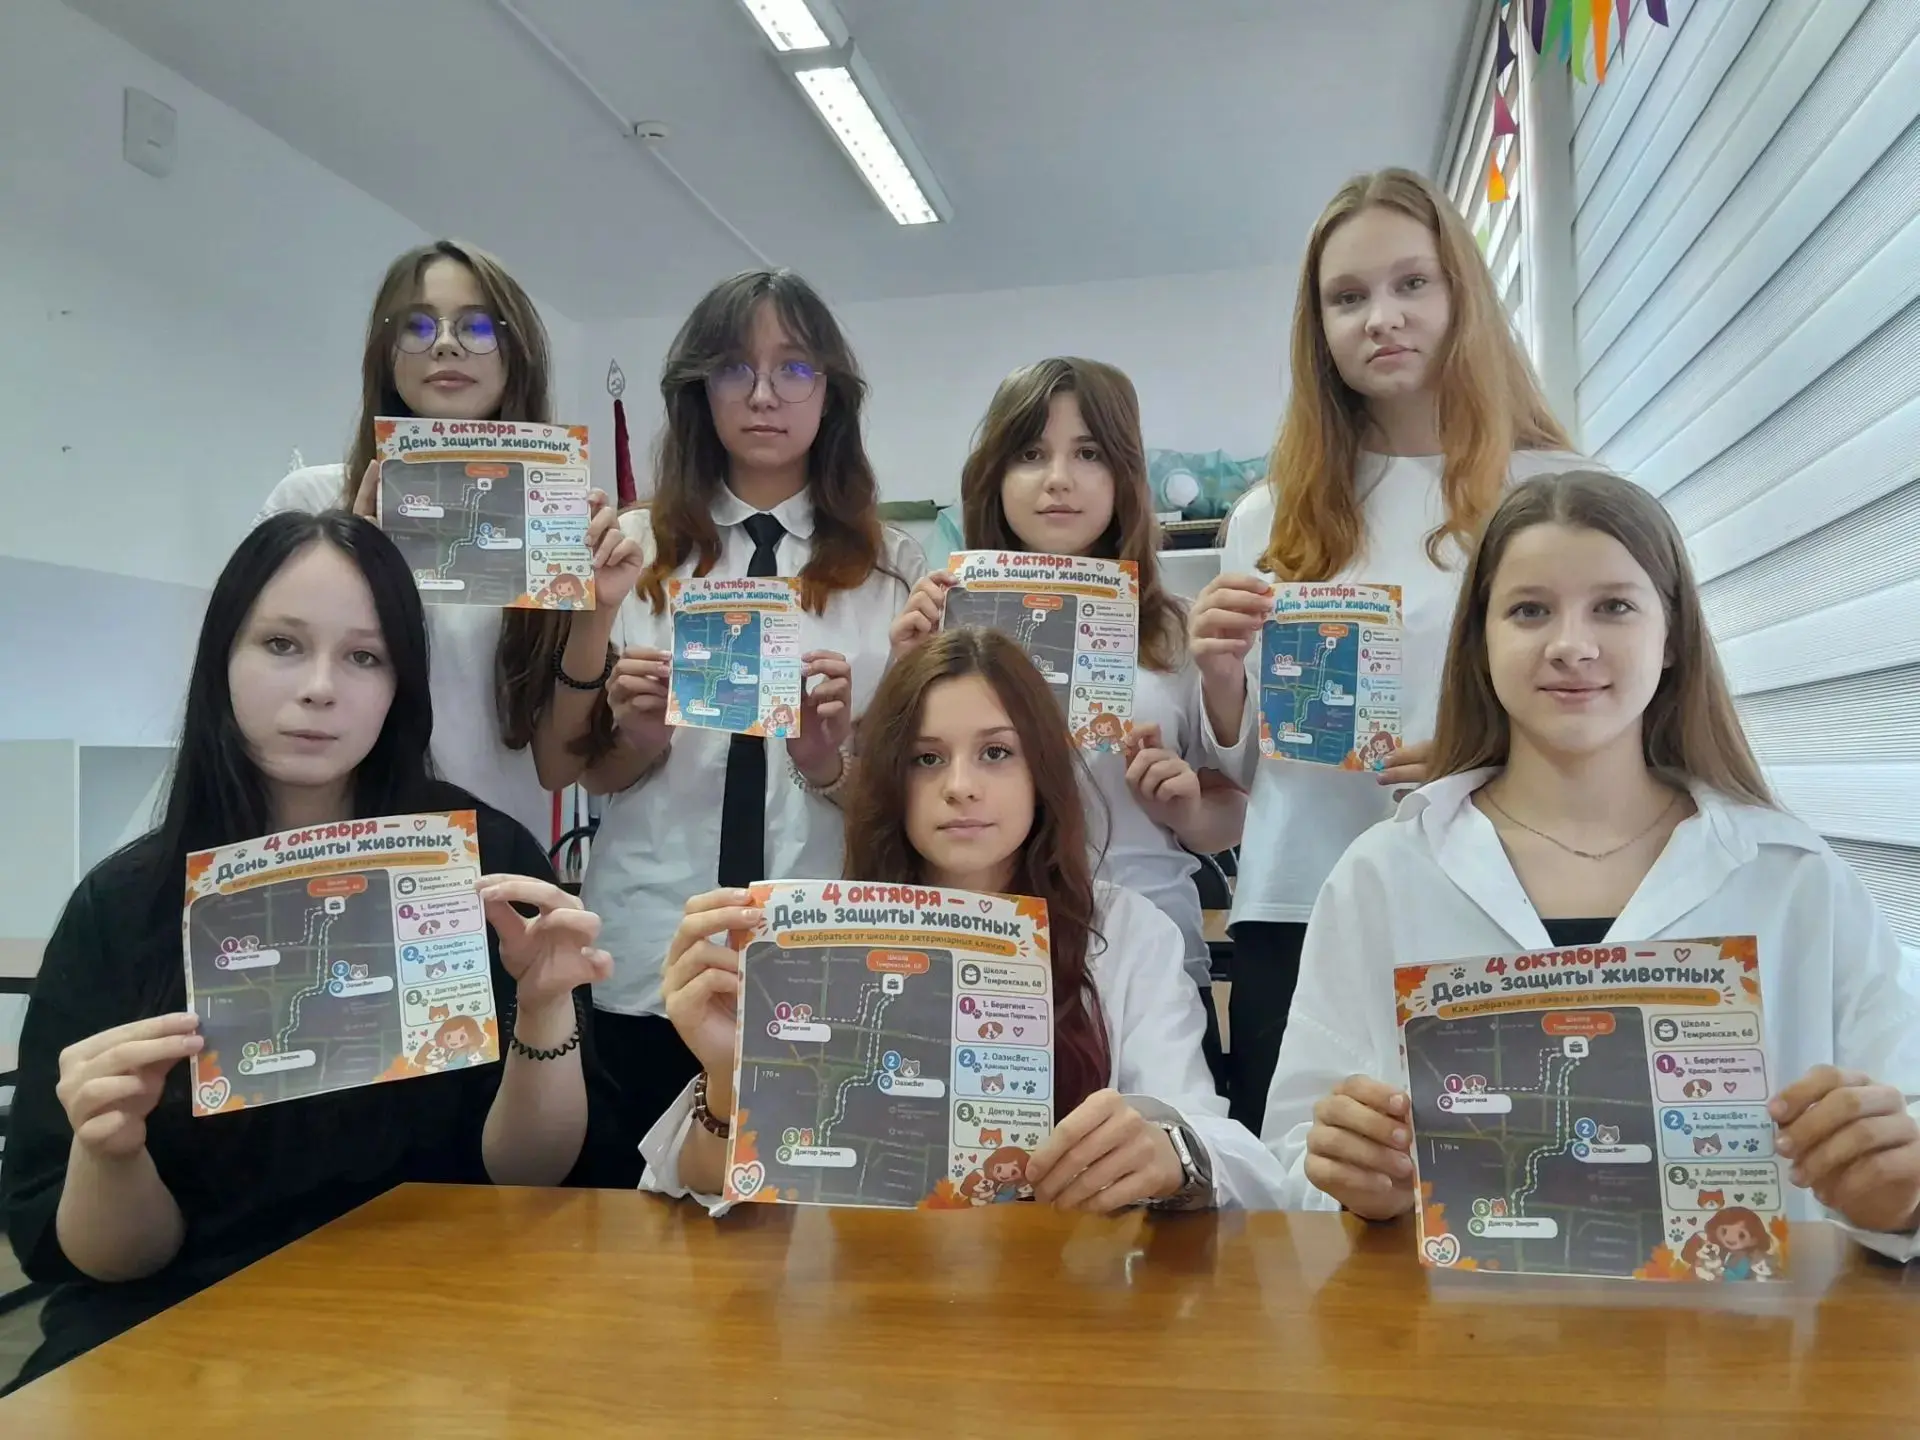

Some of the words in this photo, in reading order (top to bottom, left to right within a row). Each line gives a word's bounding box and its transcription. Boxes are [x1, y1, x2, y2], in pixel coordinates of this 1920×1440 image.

[432, 422, 444, 435] 4
[450, 422, 516, 436] октября
[399, 436, 436, 451] День
[442, 436, 497, 448] защиты
[502, 438, 570, 451] животных
[996, 553, 1009, 566] 4
[1013, 555, 1072, 570] октября
[964, 566, 999, 580] День
[1004, 567, 1054, 579] защиты
[1059, 570, 1120, 586] животных
[704, 580, 711, 590] 4
[714, 580, 755, 591] октября
[1299, 585, 1308, 598] 4
[1310, 584, 1356, 600] октября
[684, 592, 706, 604] День
[710, 592, 744, 600] защиты
[747, 592, 790, 601] животных
[1276, 599, 1301, 613] День
[1304, 600, 1341, 609] защиты
[1346, 600, 1390, 612] животных
[264, 836, 281, 851] 4
[288, 820, 377, 846] октября
[216, 858, 268, 884] День
[275, 841, 350, 864] защиты
[358, 835, 452, 852] животных
[822, 883, 842, 906] 4
[848, 885, 942, 910] октября
[772, 904, 828, 931] День
[834, 908, 914, 925] защиты
[921, 912, 1020, 937] животных
[808, 932, 852, 942] добраться
[912, 936, 972, 944] ветеринарных
[1485, 957, 1508, 975] 4
[1514, 946, 1626, 972] октября
[1431, 980, 1492, 1006] День
[1500, 970, 1593, 991] защиты
[1602, 967, 1725, 984] животных
[1452, 1004, 1468, 1013] Как
[1472, 998, 1523, 1012] добраться
[1576, 994, 1588, 1002] до
[1670, 1114, 1678, 1126] 2
